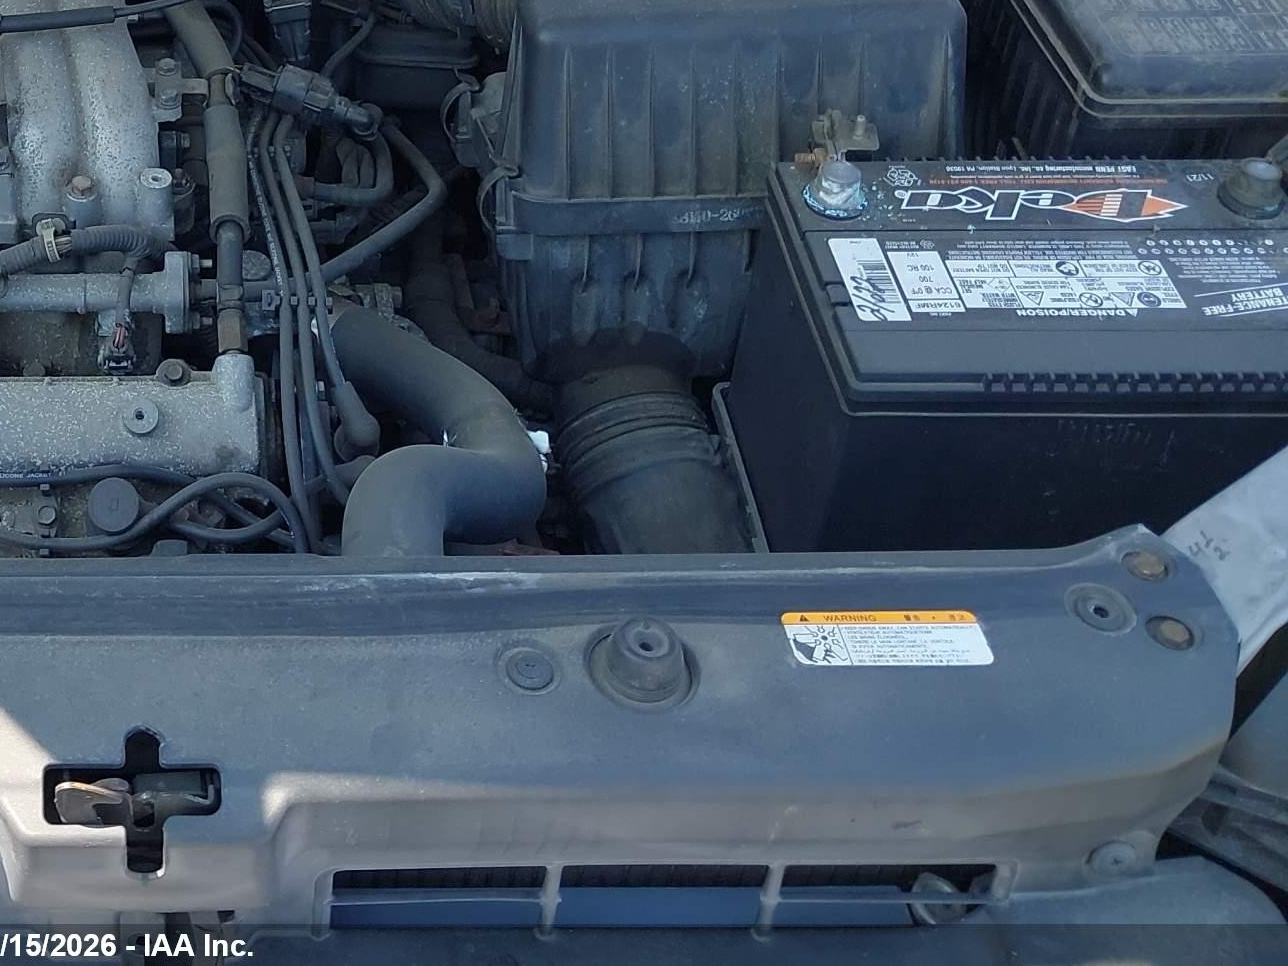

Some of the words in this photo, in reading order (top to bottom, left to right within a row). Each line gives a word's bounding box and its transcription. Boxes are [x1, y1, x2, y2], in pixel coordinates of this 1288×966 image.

[901, 187, 1152, 222] Deka
[920, 264, 934, 272] 100
[934, 287, 952, 295] CCA
[1231, 287, 1284, 302] BATTERY
[1201, 295, 1288, 316] TENANCE-FREE
[1016, 308, 1126, 317] DANGER/POISON
[823, 614, 877, 622] WARNING
